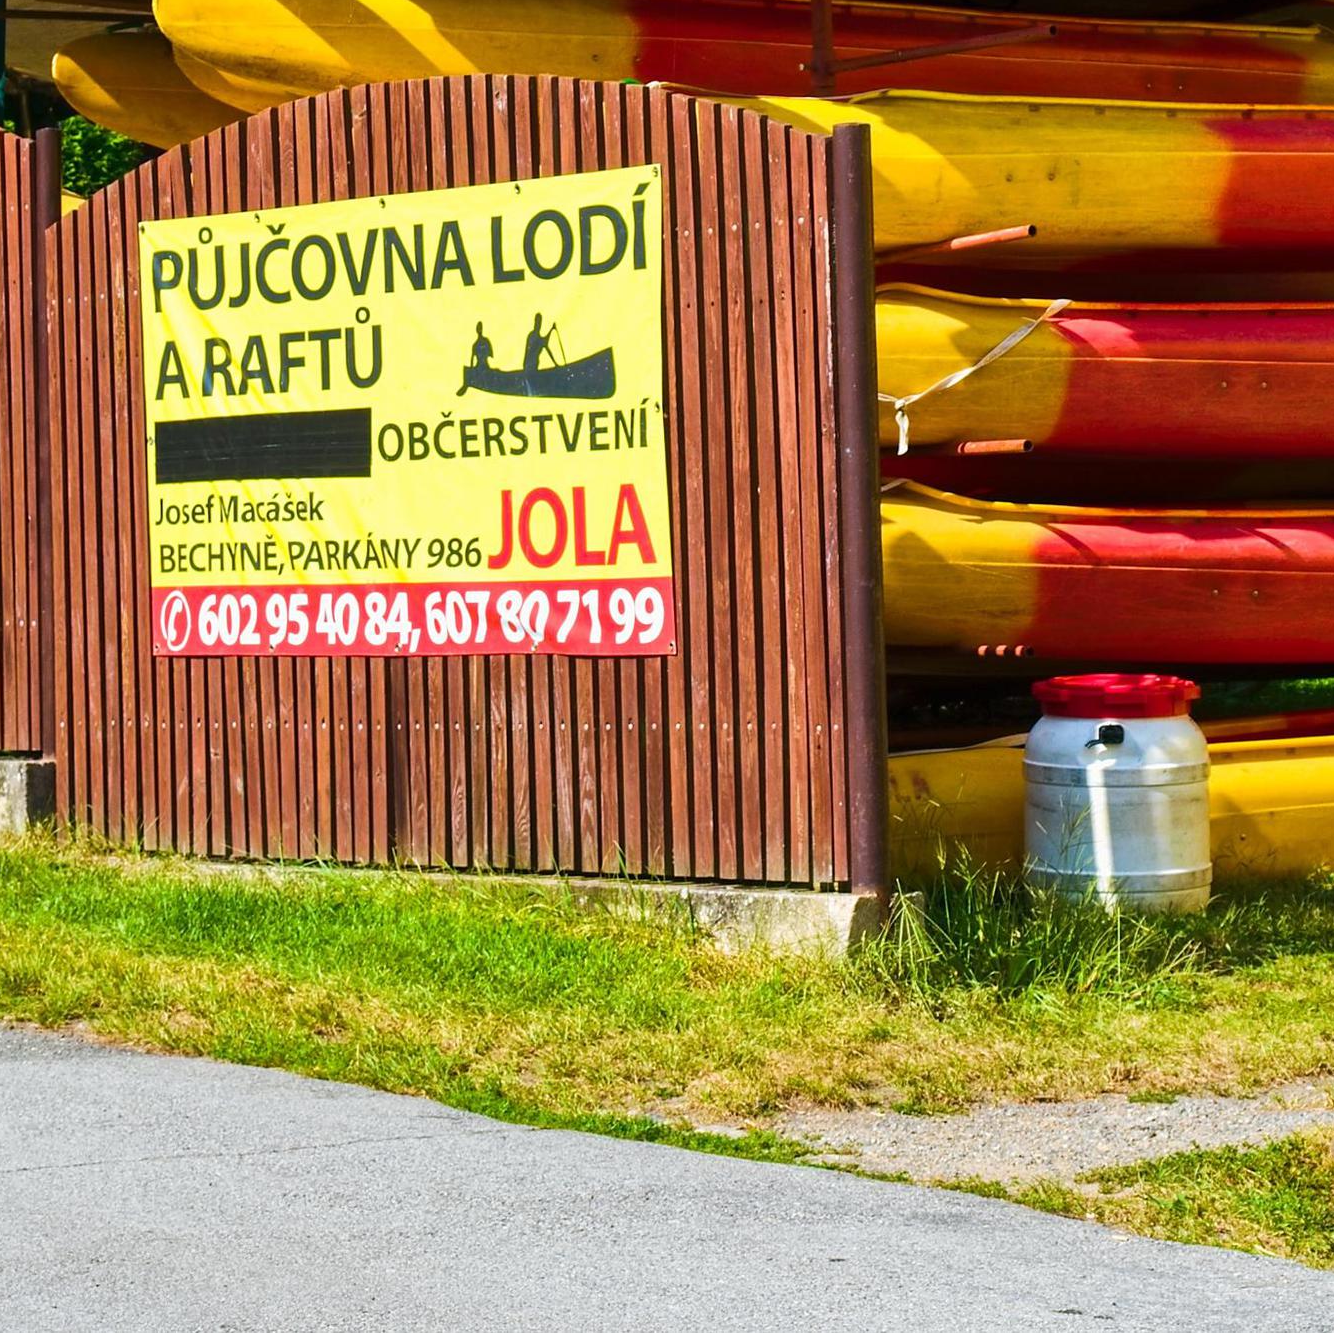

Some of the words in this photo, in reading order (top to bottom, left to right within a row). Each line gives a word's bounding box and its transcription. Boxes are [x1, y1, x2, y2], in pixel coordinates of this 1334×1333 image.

[153, 220, 474, 313] PŮJČOVNA
[491, 181, 651, 284] LODÍ
[155, 340, 190, 401] A
[201, 306, 383, 397] RAFTŮ
[378, 398, 649, 462] OBČERSTVENÍ
[155, 494, 214, 526] Josef
[219, 491, 324, 523] Macášek
[487, 483, 657, 570] JOLA
[427, 537, 482, 569] 986
[198, 593, 261, 646] 602
[266, 593, 310, 646] 95
[316, 592, 360, 646] 40
[424, 589, 491, 646] 607
[496, 589, 550, 646] 80
[556, 588, 602, 644] 71
[609, 586, 665, 645] 99
